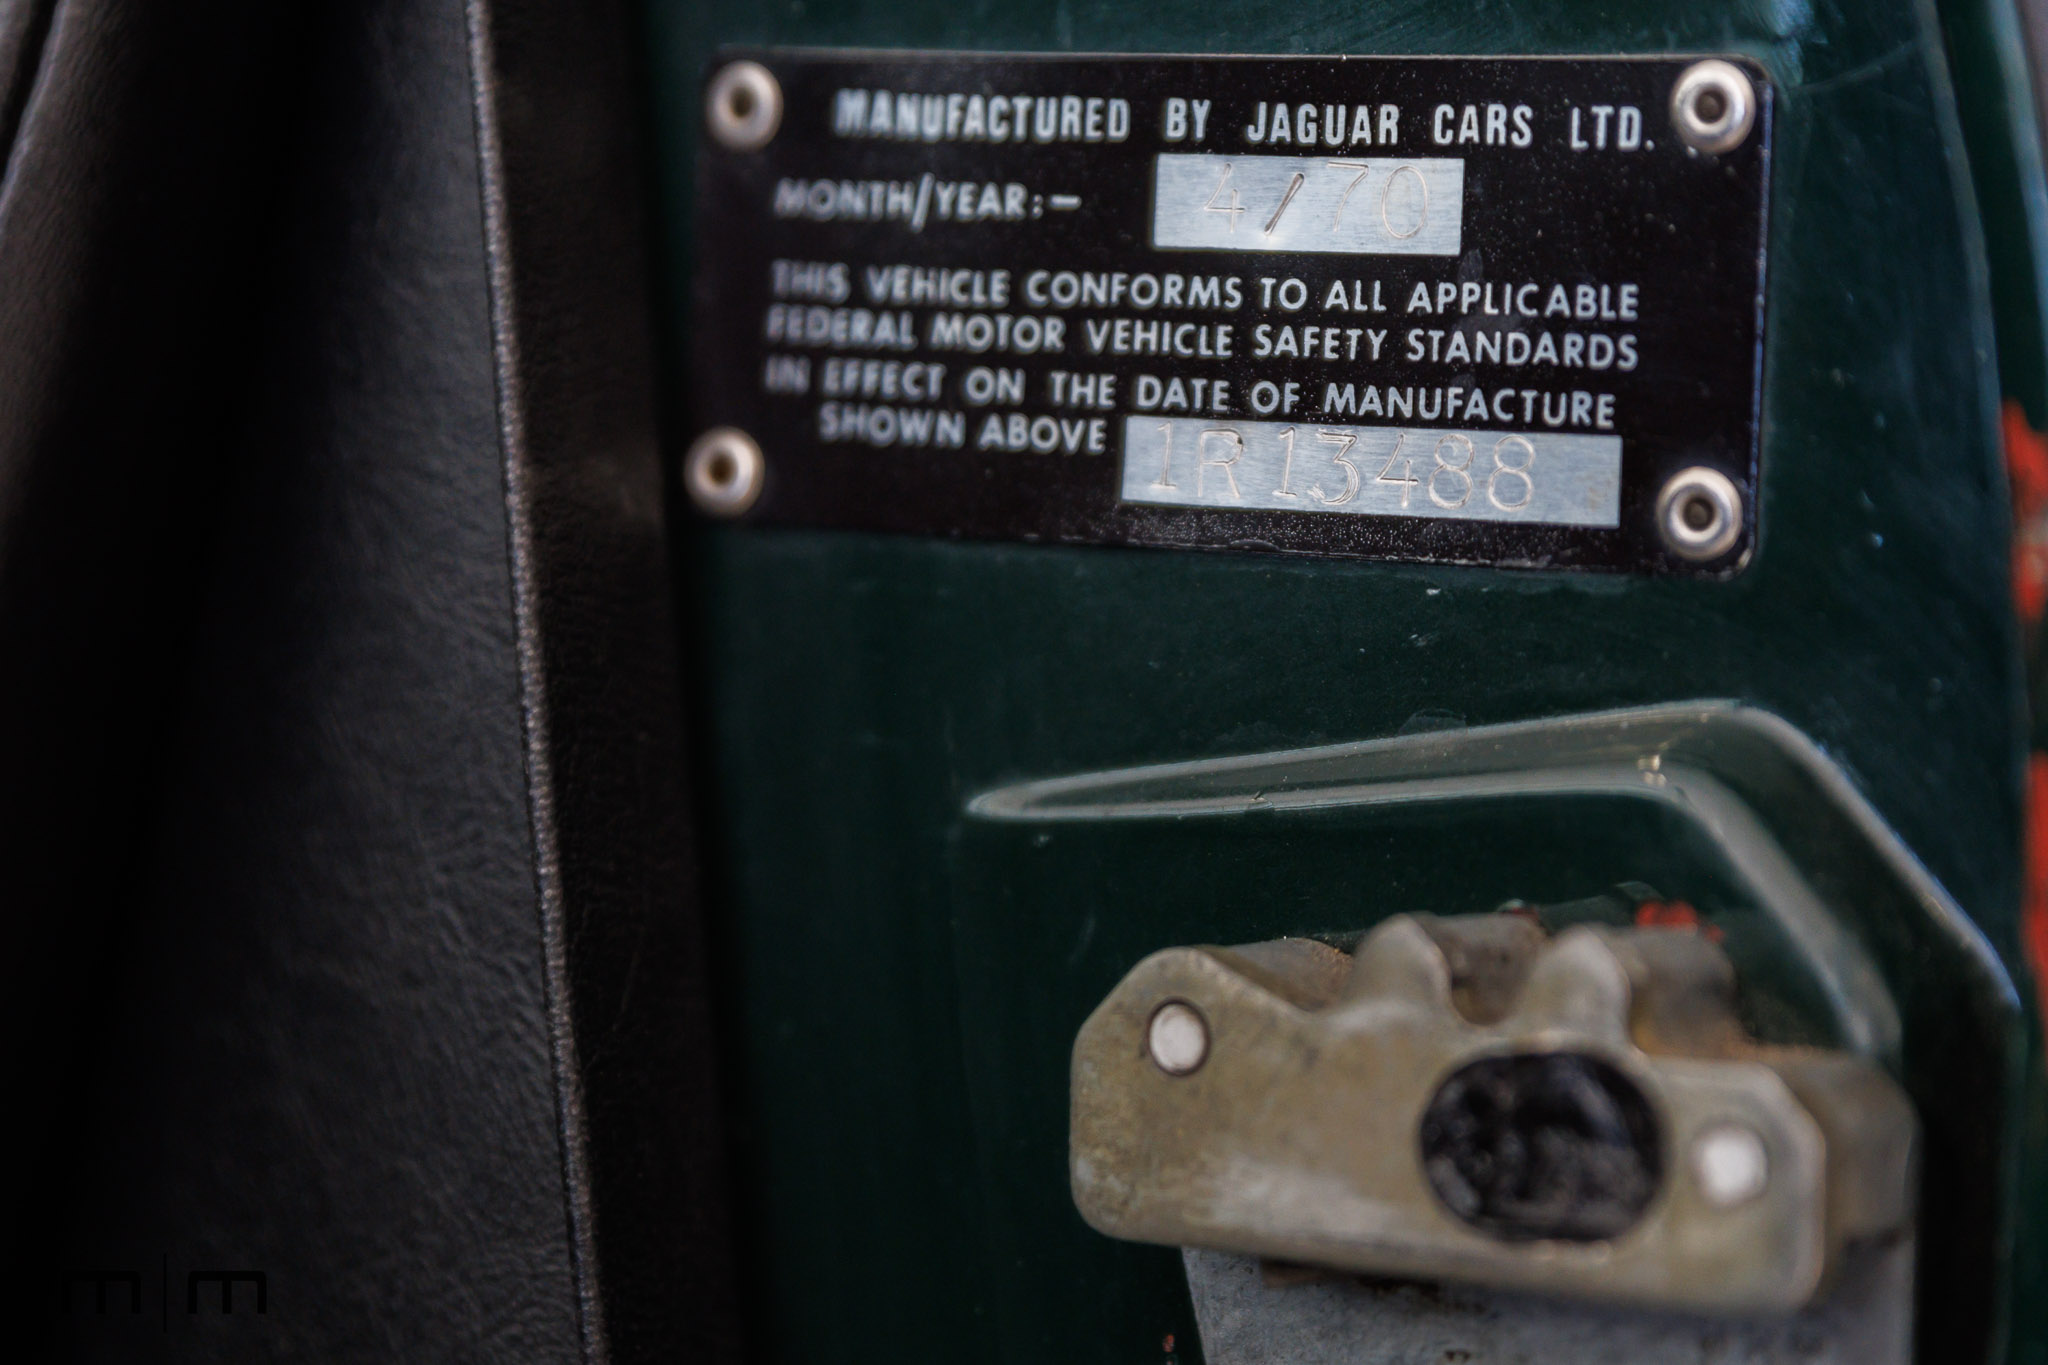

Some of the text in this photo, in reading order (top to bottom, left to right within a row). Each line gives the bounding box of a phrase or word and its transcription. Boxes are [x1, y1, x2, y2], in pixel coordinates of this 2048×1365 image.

[834, 88, 1656, 151] MANUFACTURED BY JAGUAR CARS LTD.
[770, 258, 1640, 321] THIS VEHICLE CONFORMS TO ALL APPLICABLE
[765, 303, 1638, 371] FEDERAL MOTOR VEHICLE SAFETY STANDARDS
[763, 354, 1615, 429] IN EFFECT ON THE DATE OF MANUFACTURE
[817, 401, 967, 448] SHOWN
[977, 412, 1108, 455] ABOVE
